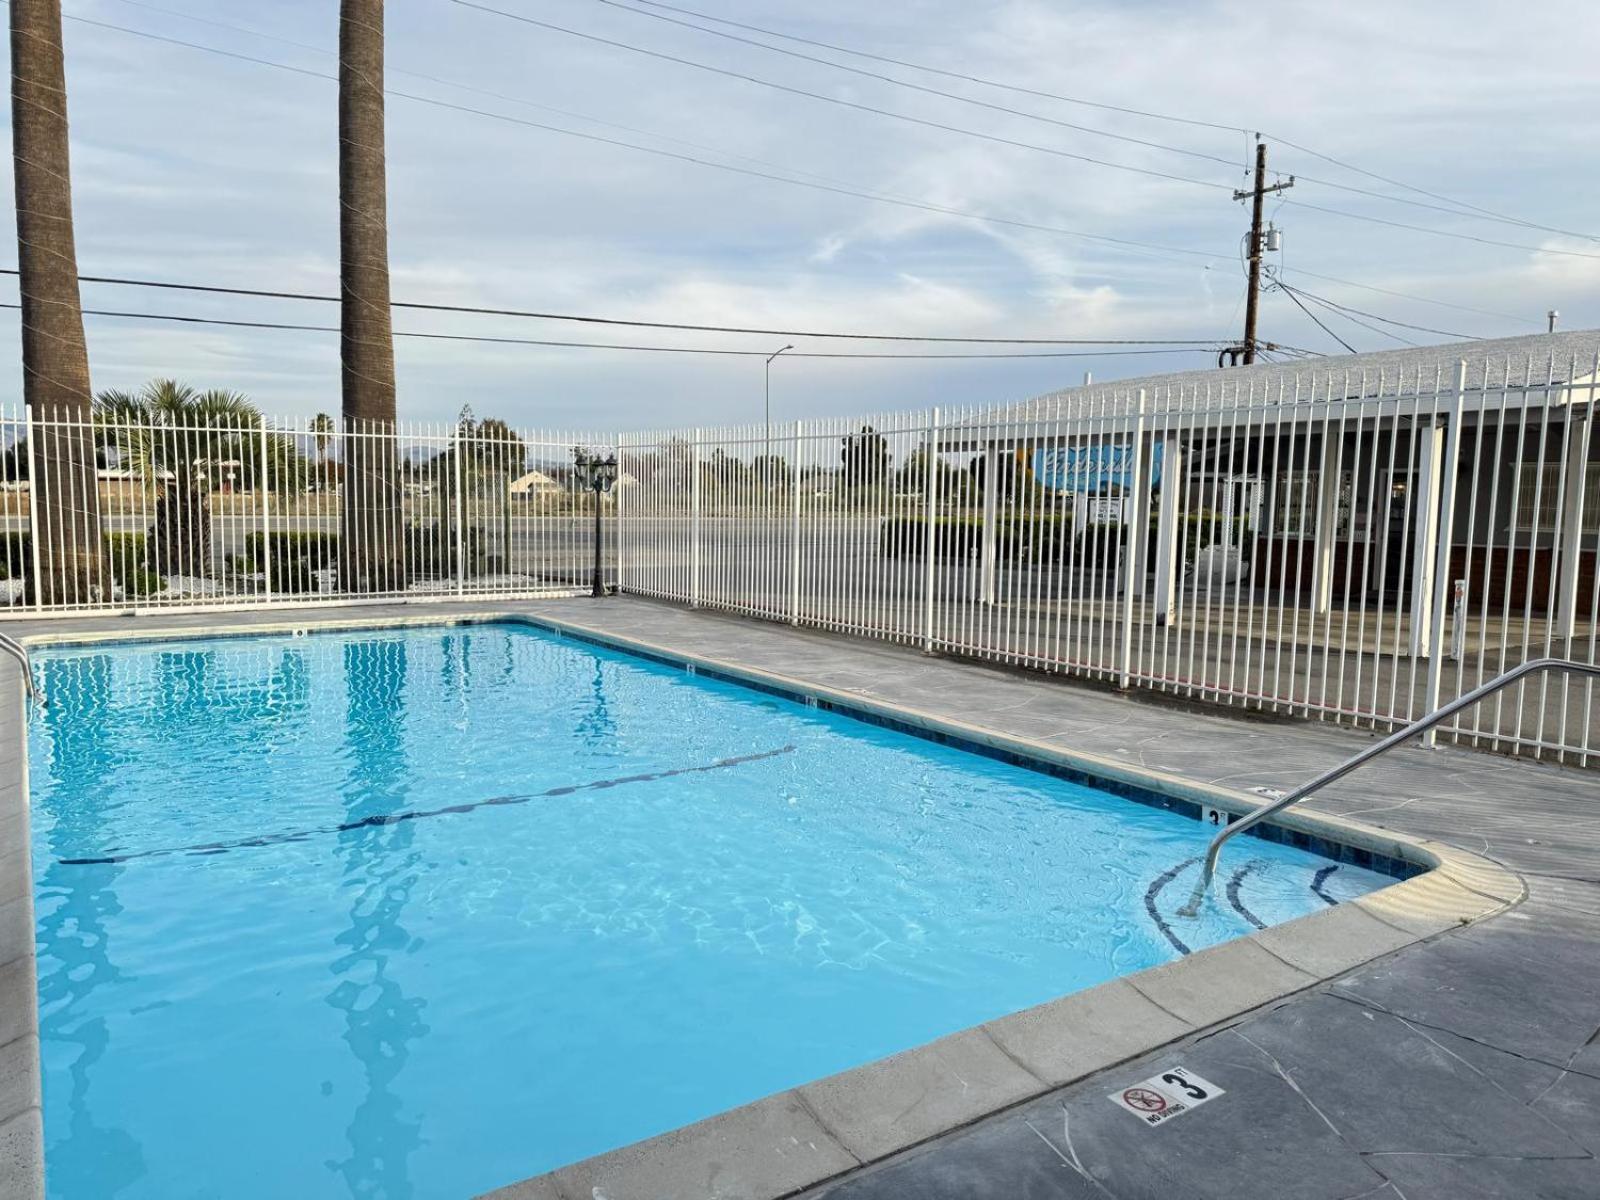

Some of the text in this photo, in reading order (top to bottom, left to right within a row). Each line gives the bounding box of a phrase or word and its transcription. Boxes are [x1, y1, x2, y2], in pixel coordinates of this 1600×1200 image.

[1162, 1073, 1208, 1100] 3
[1146, 1103, 1185, 1124] NO DIVING
